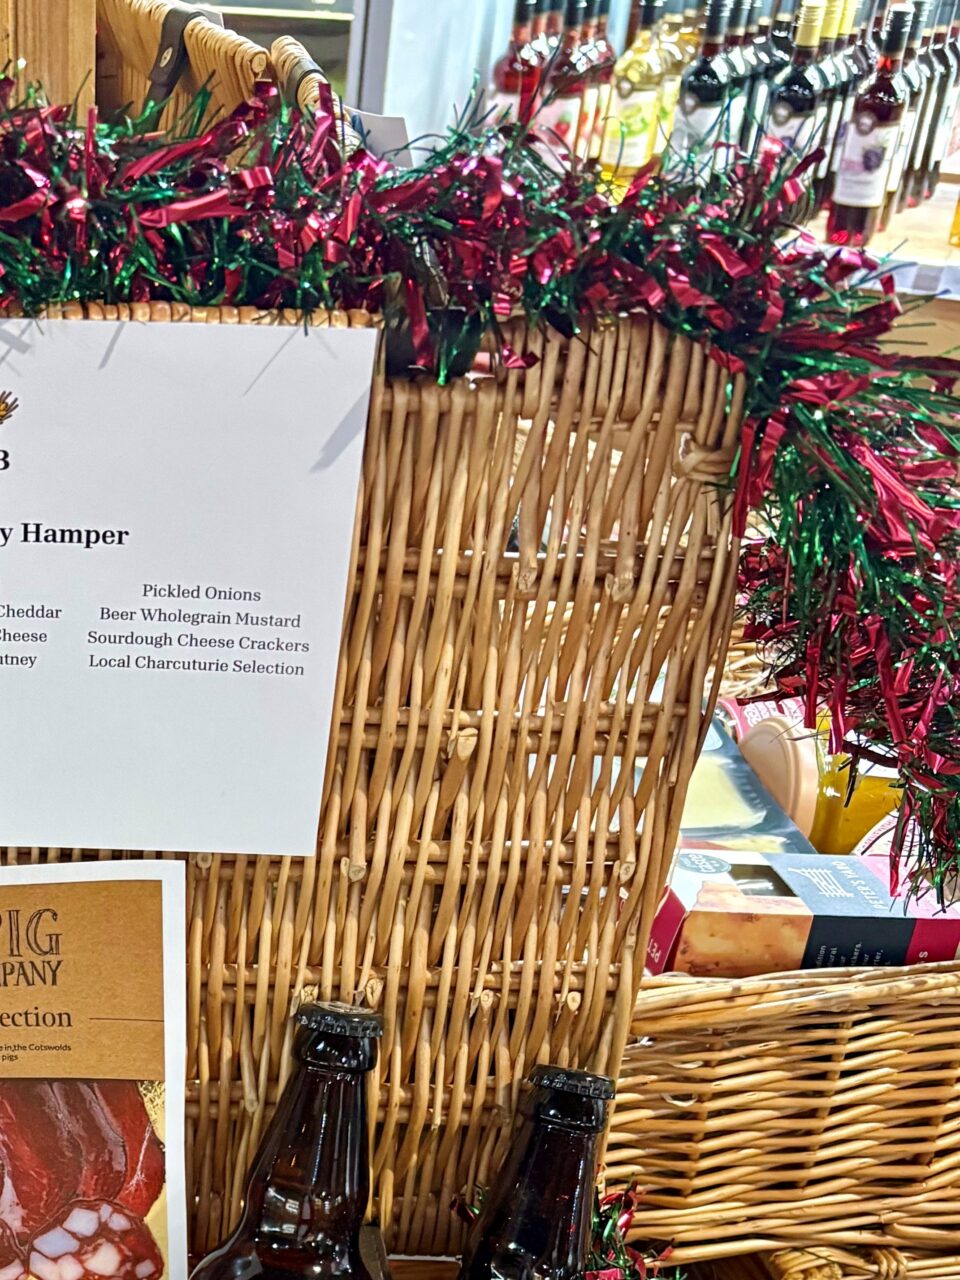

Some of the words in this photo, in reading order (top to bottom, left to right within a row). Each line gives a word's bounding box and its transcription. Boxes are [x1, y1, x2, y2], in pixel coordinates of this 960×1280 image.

[20, 522, 130, 549] Hamper
[142, 583, 201, 600] Pickled
[204, 586, 262, 602] Onions
[99, 607, 136, 622] Beer
[140, 608, 232, 628] Wholegrain
[235, 612, 301, 628] Mustard
[87, 630, 174, 649] Sourdough
[177, 633, 235, 650] Cheese
[238, 637, 310, 653] Crackers
[88, 654, 131, 669] Local
[134, 656, 229, 673] Charcuturie
[232, 659, 305, 676] Selection
[28, 1042, 72, 1052] Cotswolds
